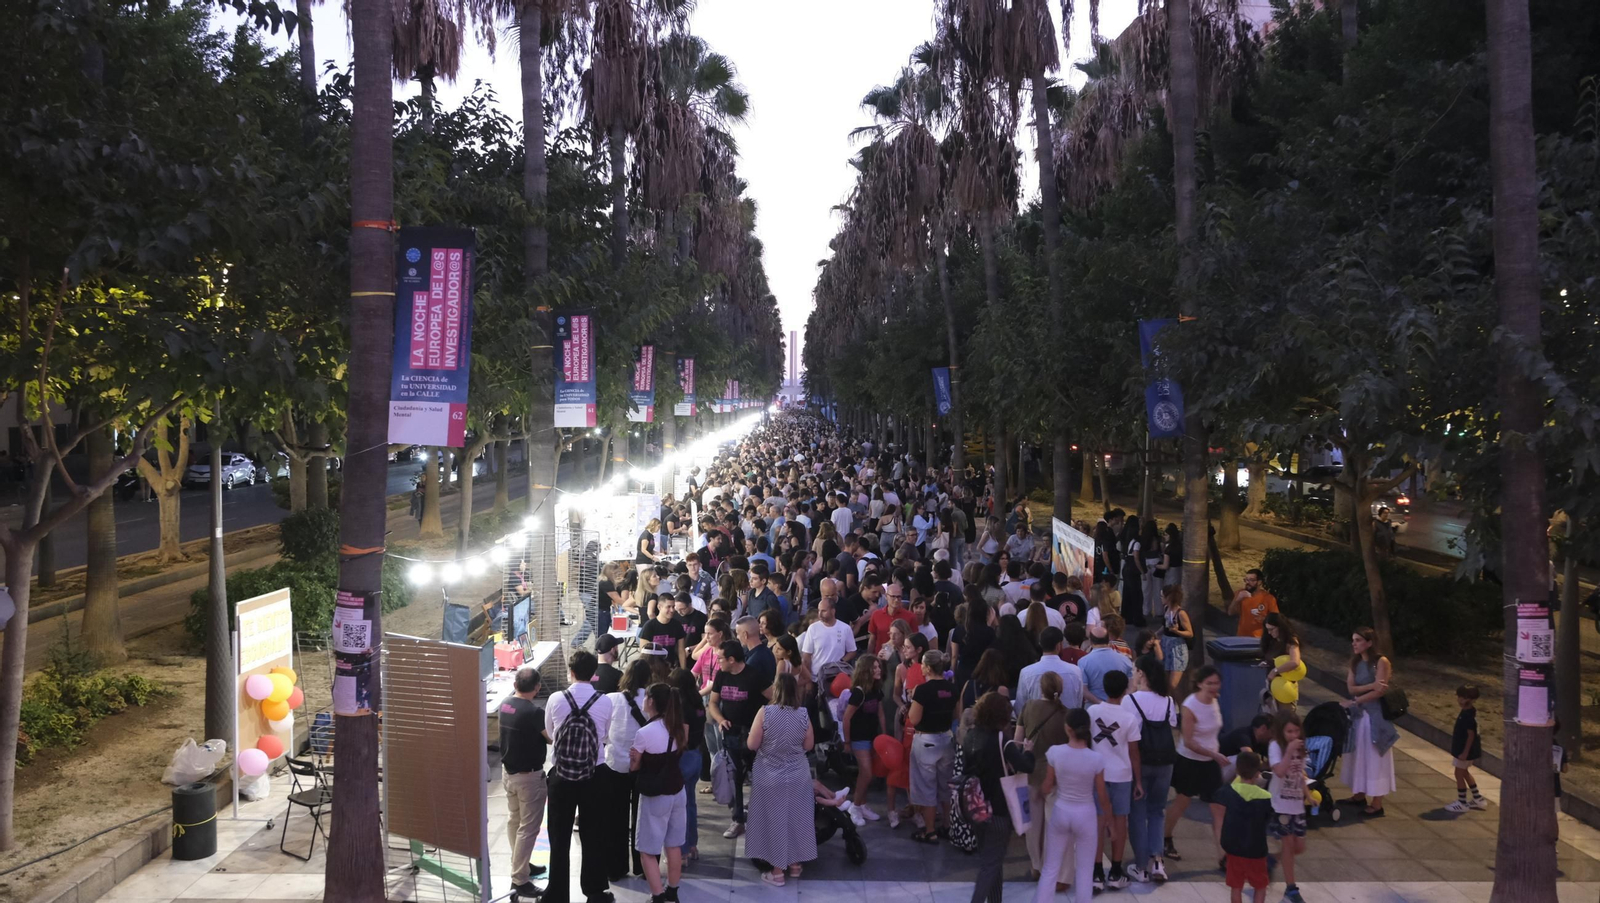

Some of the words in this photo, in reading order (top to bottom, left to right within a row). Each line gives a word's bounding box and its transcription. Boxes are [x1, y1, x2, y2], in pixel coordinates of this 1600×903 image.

[433, 252, 445, 278] L@S
[431, 282, 444, 299] DE
[414, 294, 427, 341] NOCHE
[444, 252, 461, 368] INVESTIGADOR@S
[428, 304, 443, 367] EUROPEA
[572, 334, 579, 344] DE
[413, 348, 424, 366] LA
[566, 371, 572, 381] LA
[452, 412, 462, 420] 62
